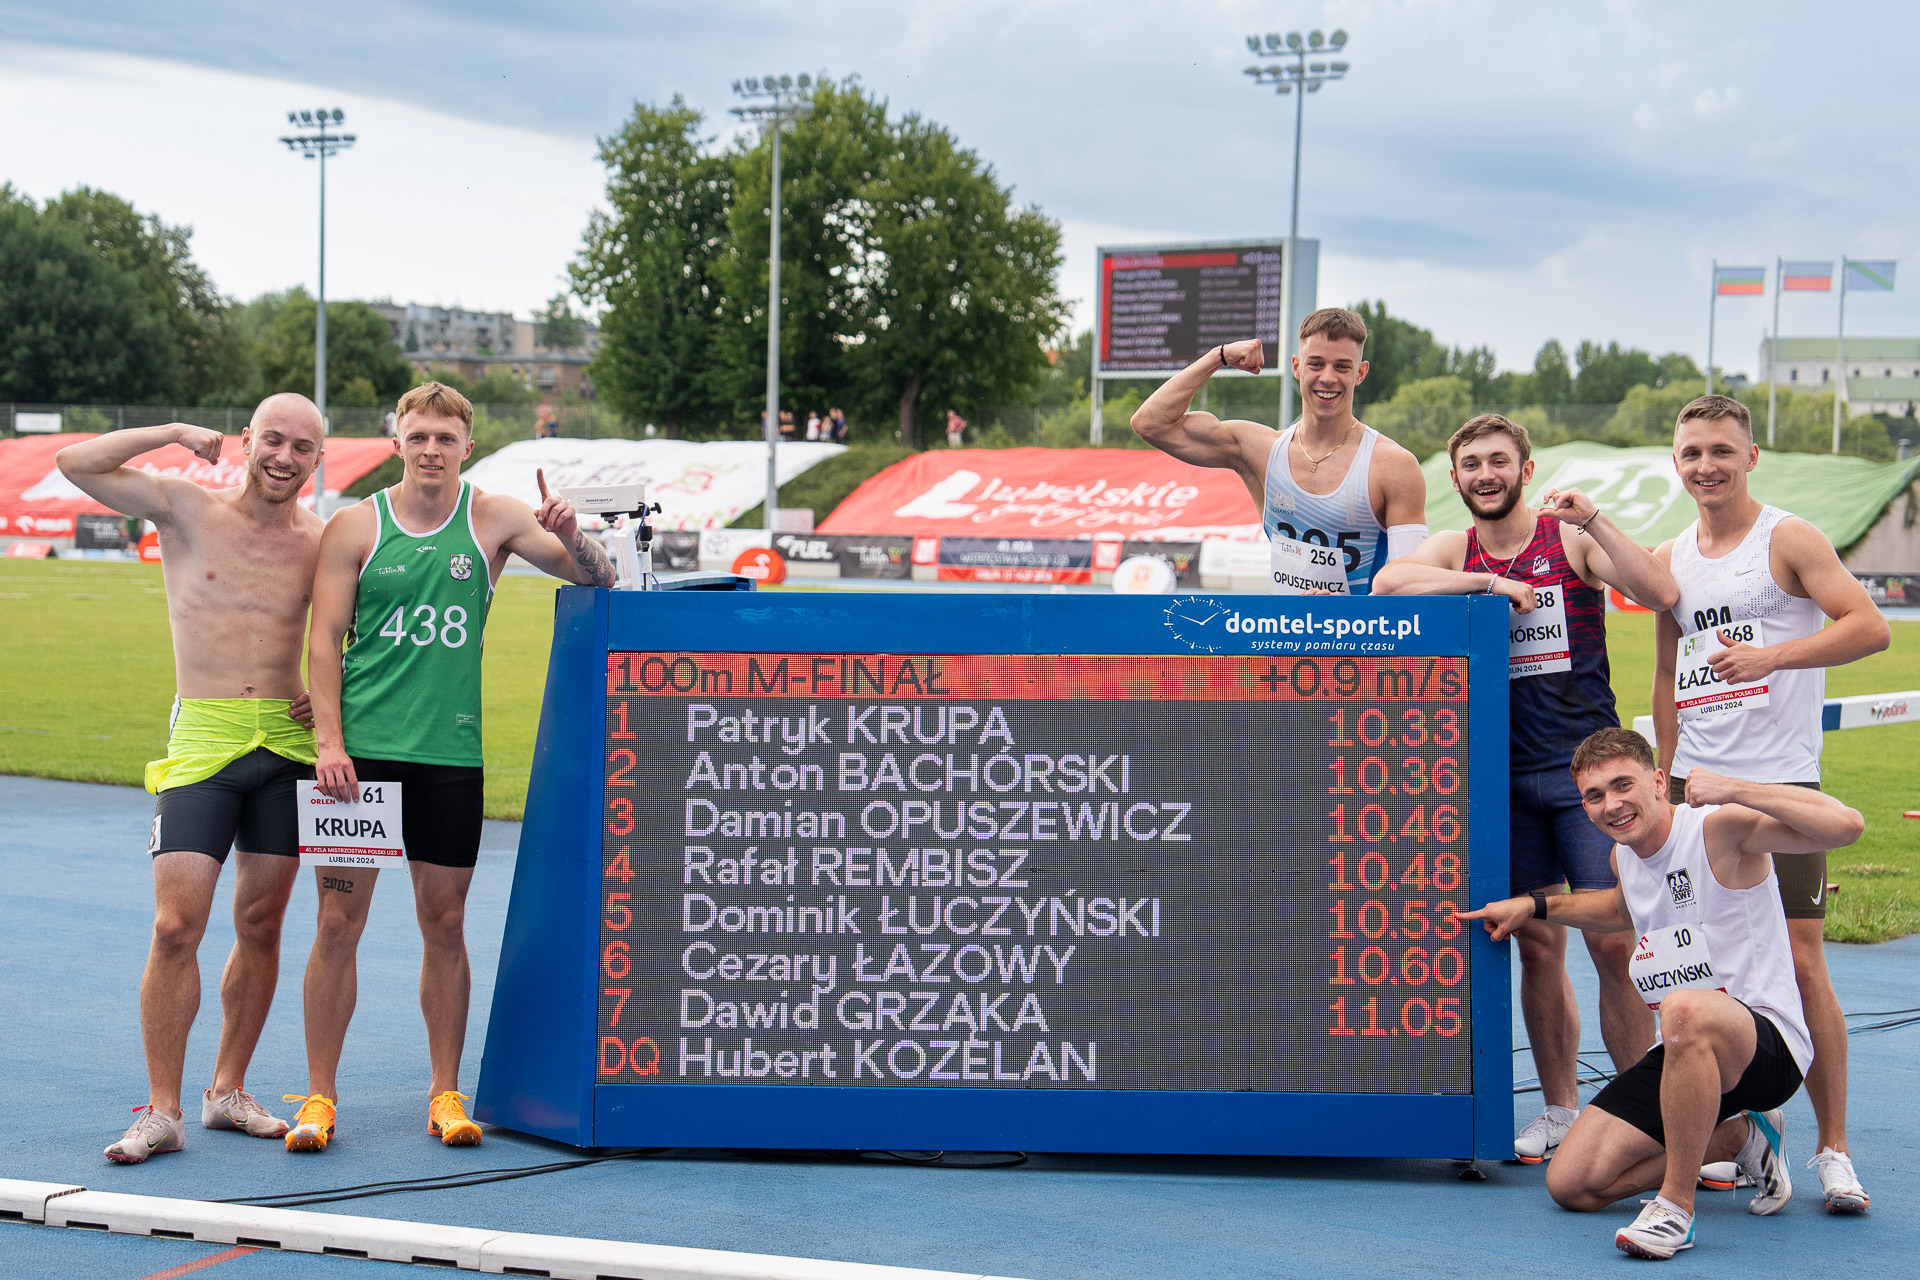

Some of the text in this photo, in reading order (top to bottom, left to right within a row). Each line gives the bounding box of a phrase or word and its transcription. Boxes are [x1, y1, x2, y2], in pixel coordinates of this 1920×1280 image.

[1310, 549, 1337, 566] 256
[1273, 571, 1346, 593] OPUSZEWICZ
[379, 604, 468, 648] 438
[1225, 611, 1421, 640] domtel-sport.pl
[1251, 640, 1300, 651] systemy
[1304, 639, 1356, 651] pomiaru
[614, 656, 1462, 697] 100m M-FINAŁ +0.9 m/s
[1523, 664, 1542, 672] 2024
[1699, 692, 1734, 705] MISTRZOSTWA
[1734, 689, 1753, 698] POLSKI
[1753, 687, 1764, 695] U23
[1700, 700, 1743, 714] LUBLIN 2024
[611, 701, 1460, 755] 1 Patryk KRUPA 10.33
[607, 746, 1460, 795] 2 Anton BACHÓRSKI 10.36
[363, 786, 384, 804] 61
[315, 817, 387, 838] KRUPA
[608, 797, 1461, 843] 3 Damian OPUSZEWICZ 10.46
[329, 856, 355, 864] LUBLIN
[605, 845, 1461, 891] 4 Rafał REMBISZ 10.48
[1672, 882, 1691, 895] AZS
[1674, 890, 1692, 902] AWF
[604, 888, 1461, 940] 5 Dominik ŁUCZYŃSKI 10.53
[1673, 928, 1692, 948] 10
[602, 940, 1464, 994] 6 Cezary ŁAZOWY 10.60
[1635, 951, 1655, 962] ORLEN
[1636, 962, 1714, 993] ŁUCZYŃSKI
[604, 987, 632, 1027] 7
[680, 988, 819, 1030] Dawid
[1329, 996, 1463, 1037] 11.05
[599, 1036, 660, 1076] DQ
[678, 1037, 837, 1078] Hubert
